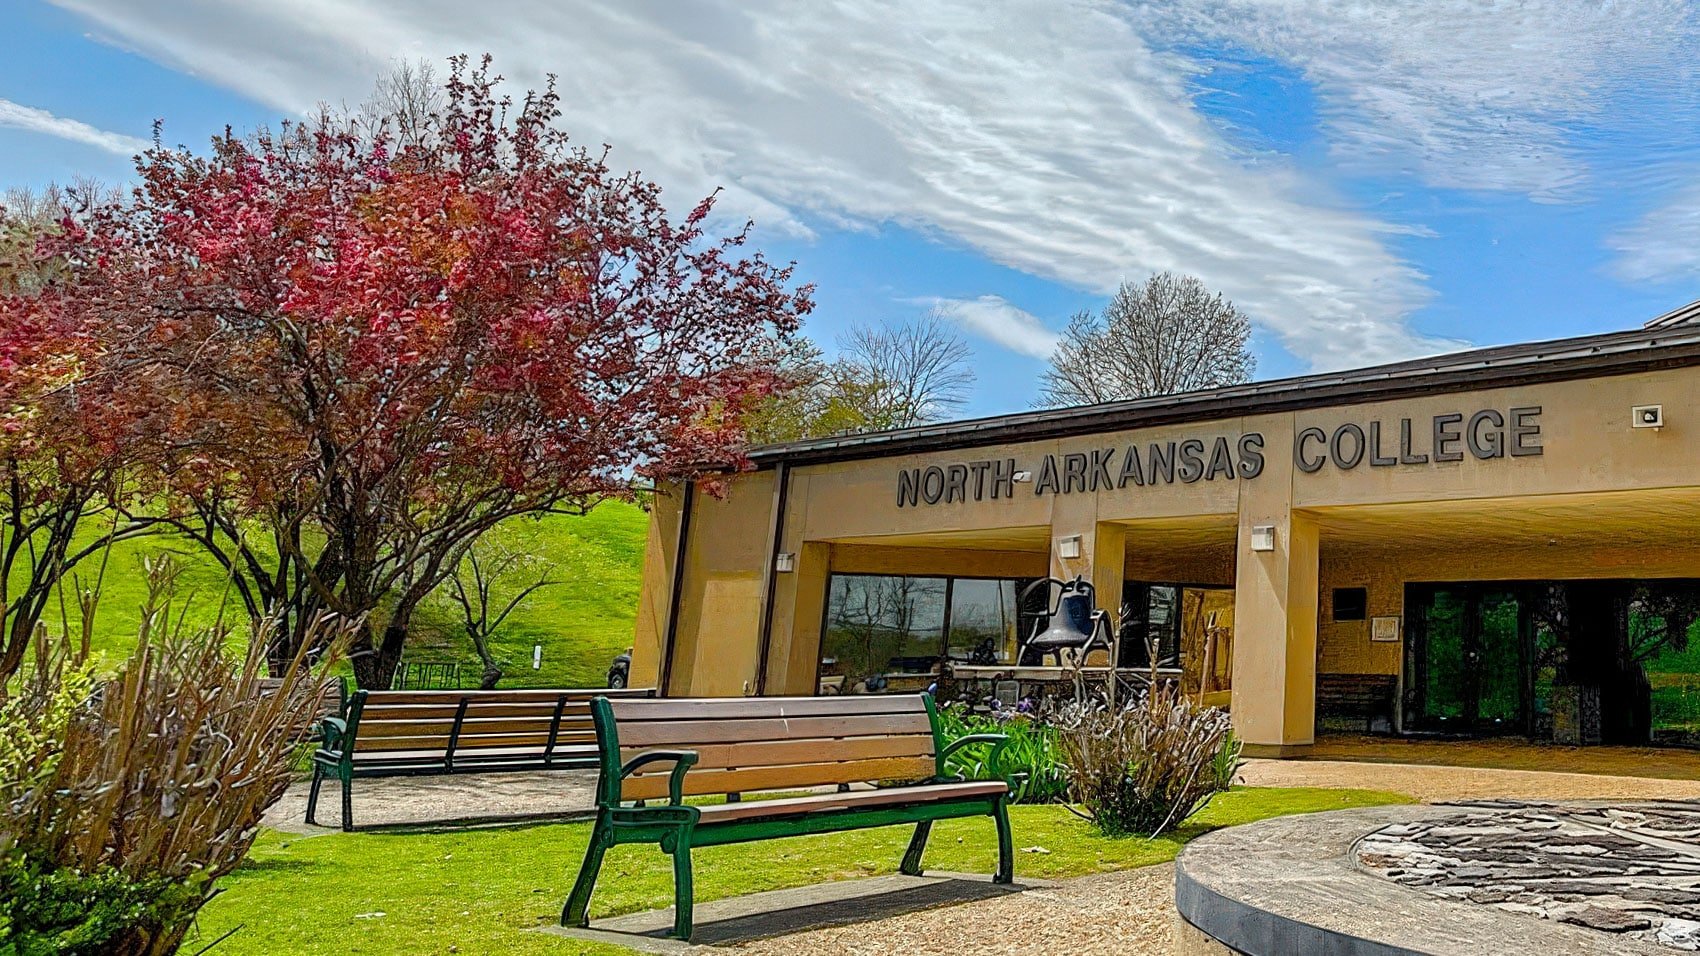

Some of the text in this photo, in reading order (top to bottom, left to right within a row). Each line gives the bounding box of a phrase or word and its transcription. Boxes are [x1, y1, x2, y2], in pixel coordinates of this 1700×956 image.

[897, 406, 1543, 507] NORTH ARKANSAS COLLEGE
